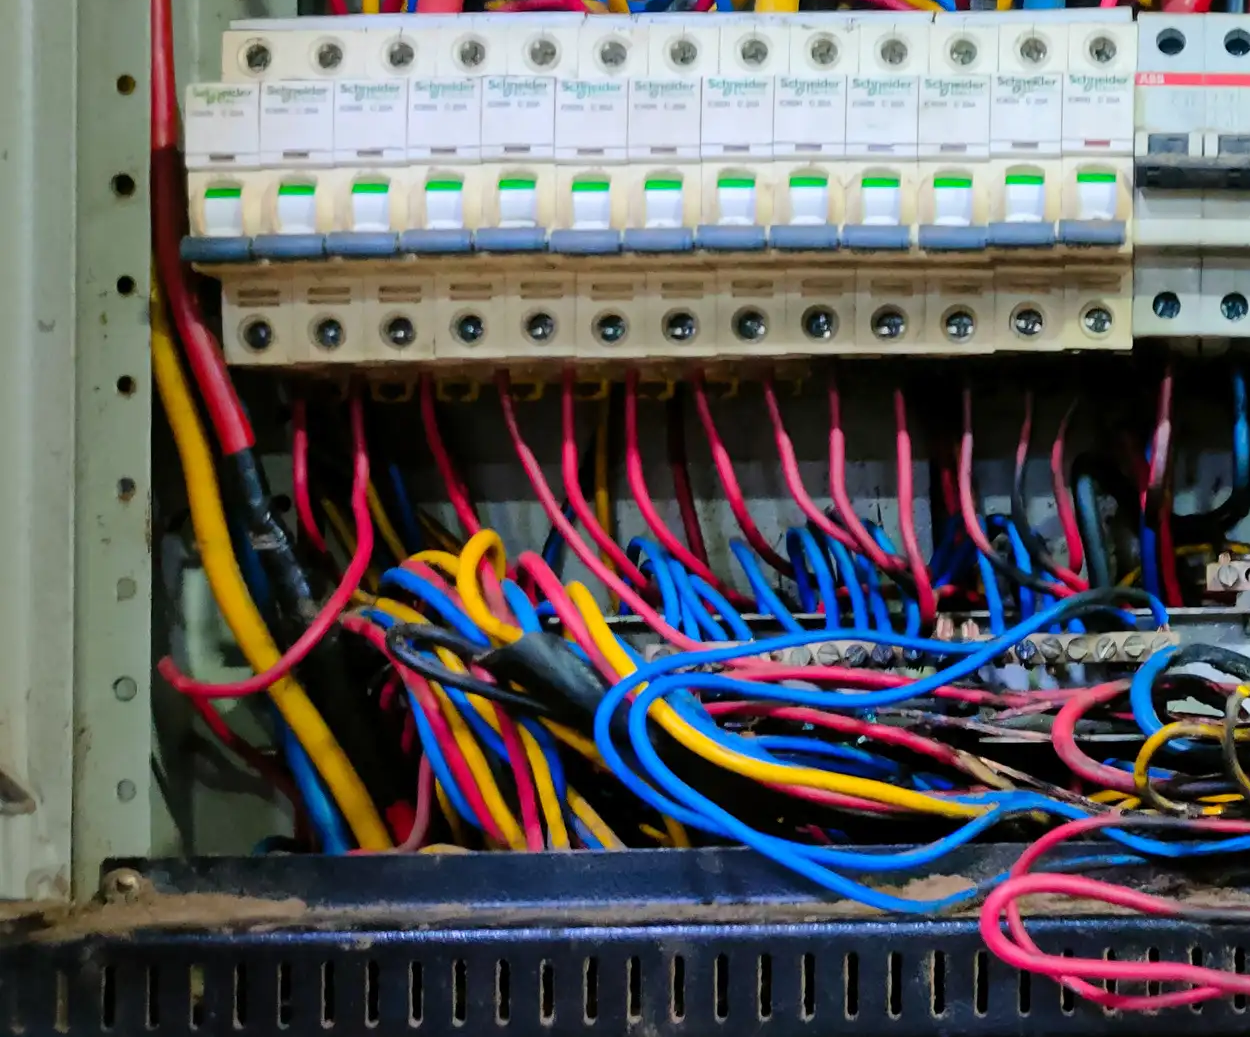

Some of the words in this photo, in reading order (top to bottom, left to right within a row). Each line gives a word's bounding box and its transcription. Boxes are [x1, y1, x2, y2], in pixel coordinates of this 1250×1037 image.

[707, 78, 768, 97] Schneider
[780, 77, 840, 96] Schneider
[852, 78, 912, 96] Schneider
[924, 79, 984, 97] Schneider
[1069, 74, 1128, 93] Schneider
[1140, 74, 1165, 84] ABB
[634, 80, 694, 99] Schneider
